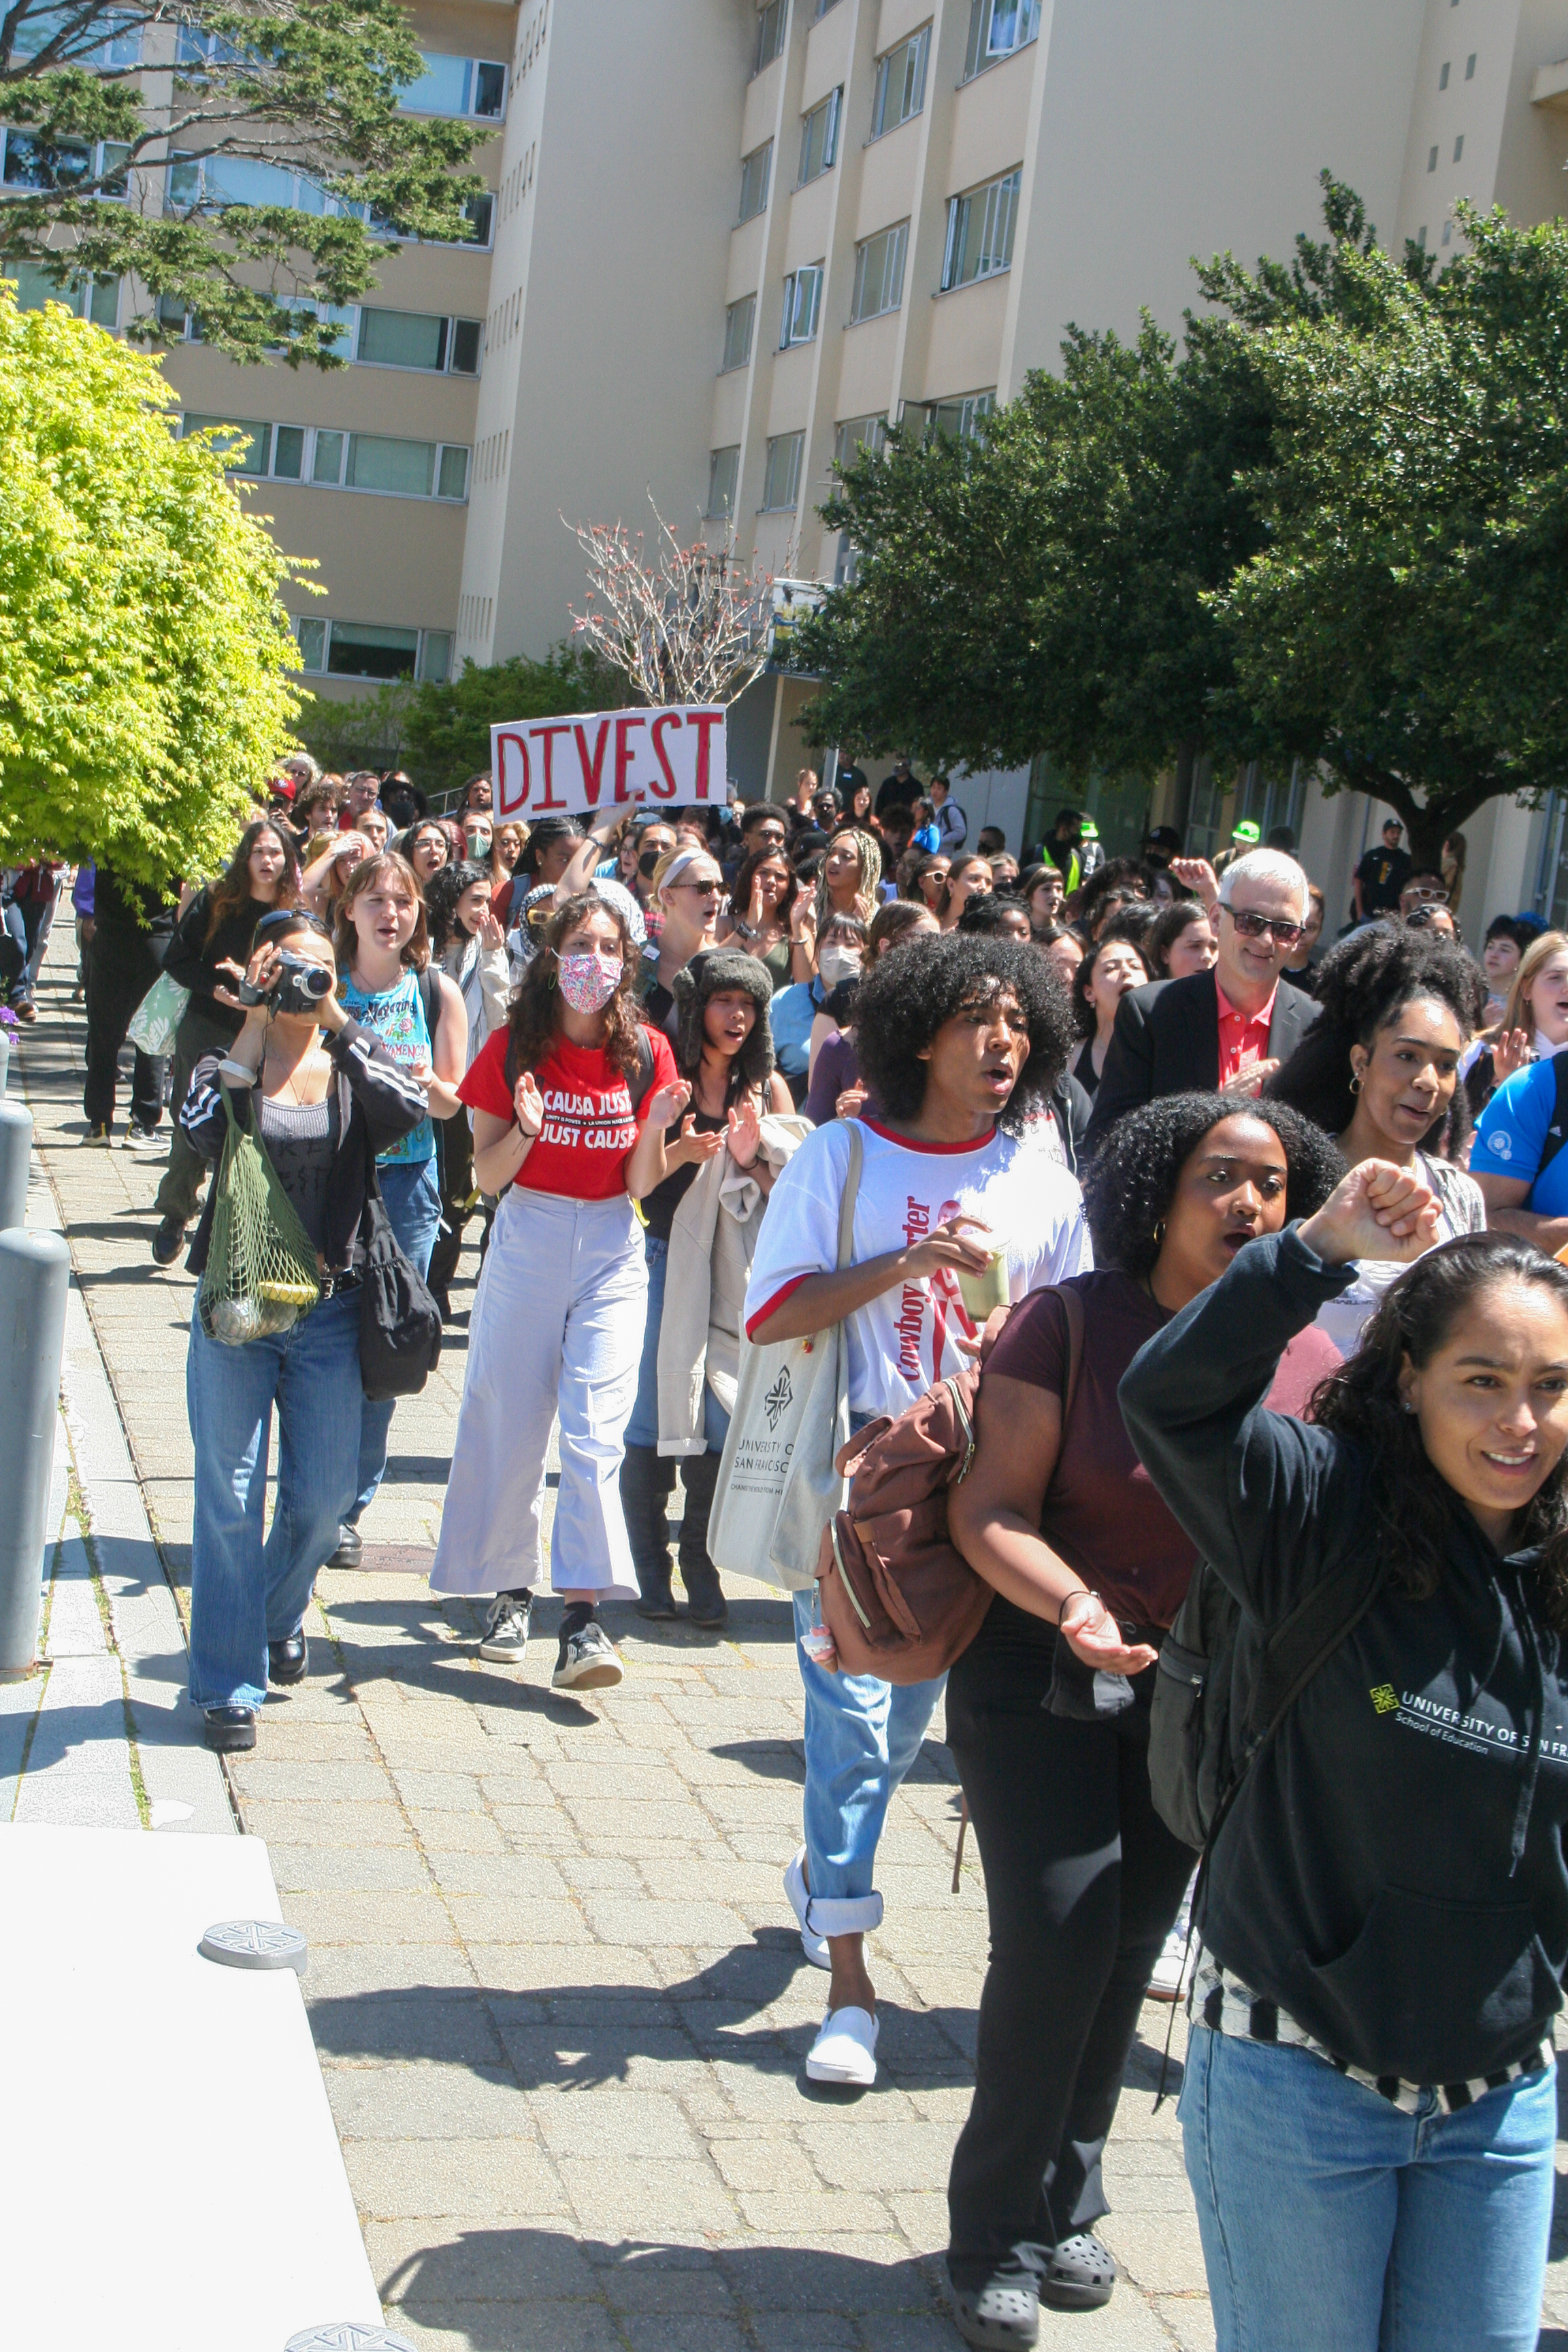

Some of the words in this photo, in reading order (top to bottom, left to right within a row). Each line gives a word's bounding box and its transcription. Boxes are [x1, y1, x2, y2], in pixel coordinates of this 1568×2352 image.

[497, 712, 724, 816] DIVEST
[544, 1090, 595, 1117] CAUSA
[540, 1123, 581, 1147] JUST
[585, 1127, 636, 1149] CAUSE
[902, 1195, 930, 1246] rter
[894, 1284, 935, 1382] Cowboy
[734, 1456, 753, 1469] SAN
[738, 1439, 782, 1454] UNIVERSTY
[1395, 1711, 1429, 1733] School
[1430, 1727, 1441, 1740] of
[1441, 1731, 1489, 1755] Education
[1402, 1691, 1495, 1735] UNIVERSITY
[1497, 1728, 1518, 1744] OF
[1521, 1735, 1549, 1752] SN
